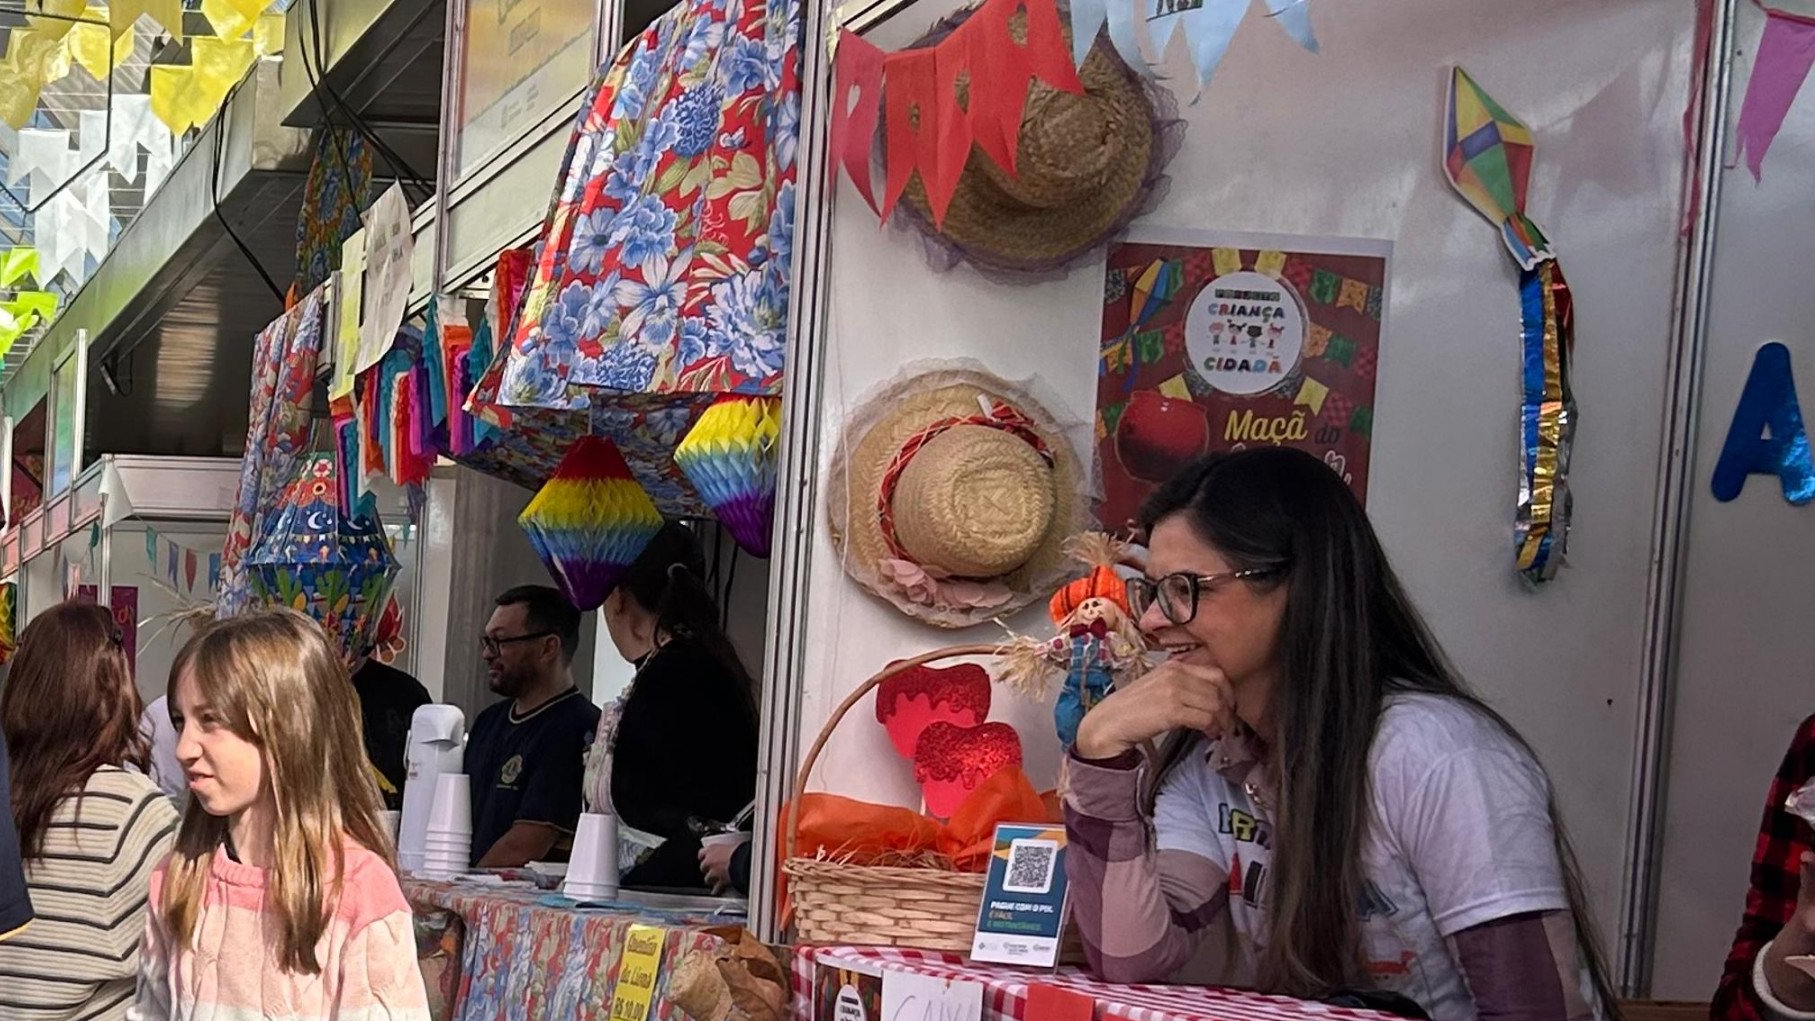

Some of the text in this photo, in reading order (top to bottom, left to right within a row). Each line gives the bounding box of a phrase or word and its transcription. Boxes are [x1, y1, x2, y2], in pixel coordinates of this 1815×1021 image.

[1207, 303, 1285, 323] CRIANÇA
[1204, 356, 1282, 374] CIDADÃ
[1224, 409, 1342, 447] Maçã do
